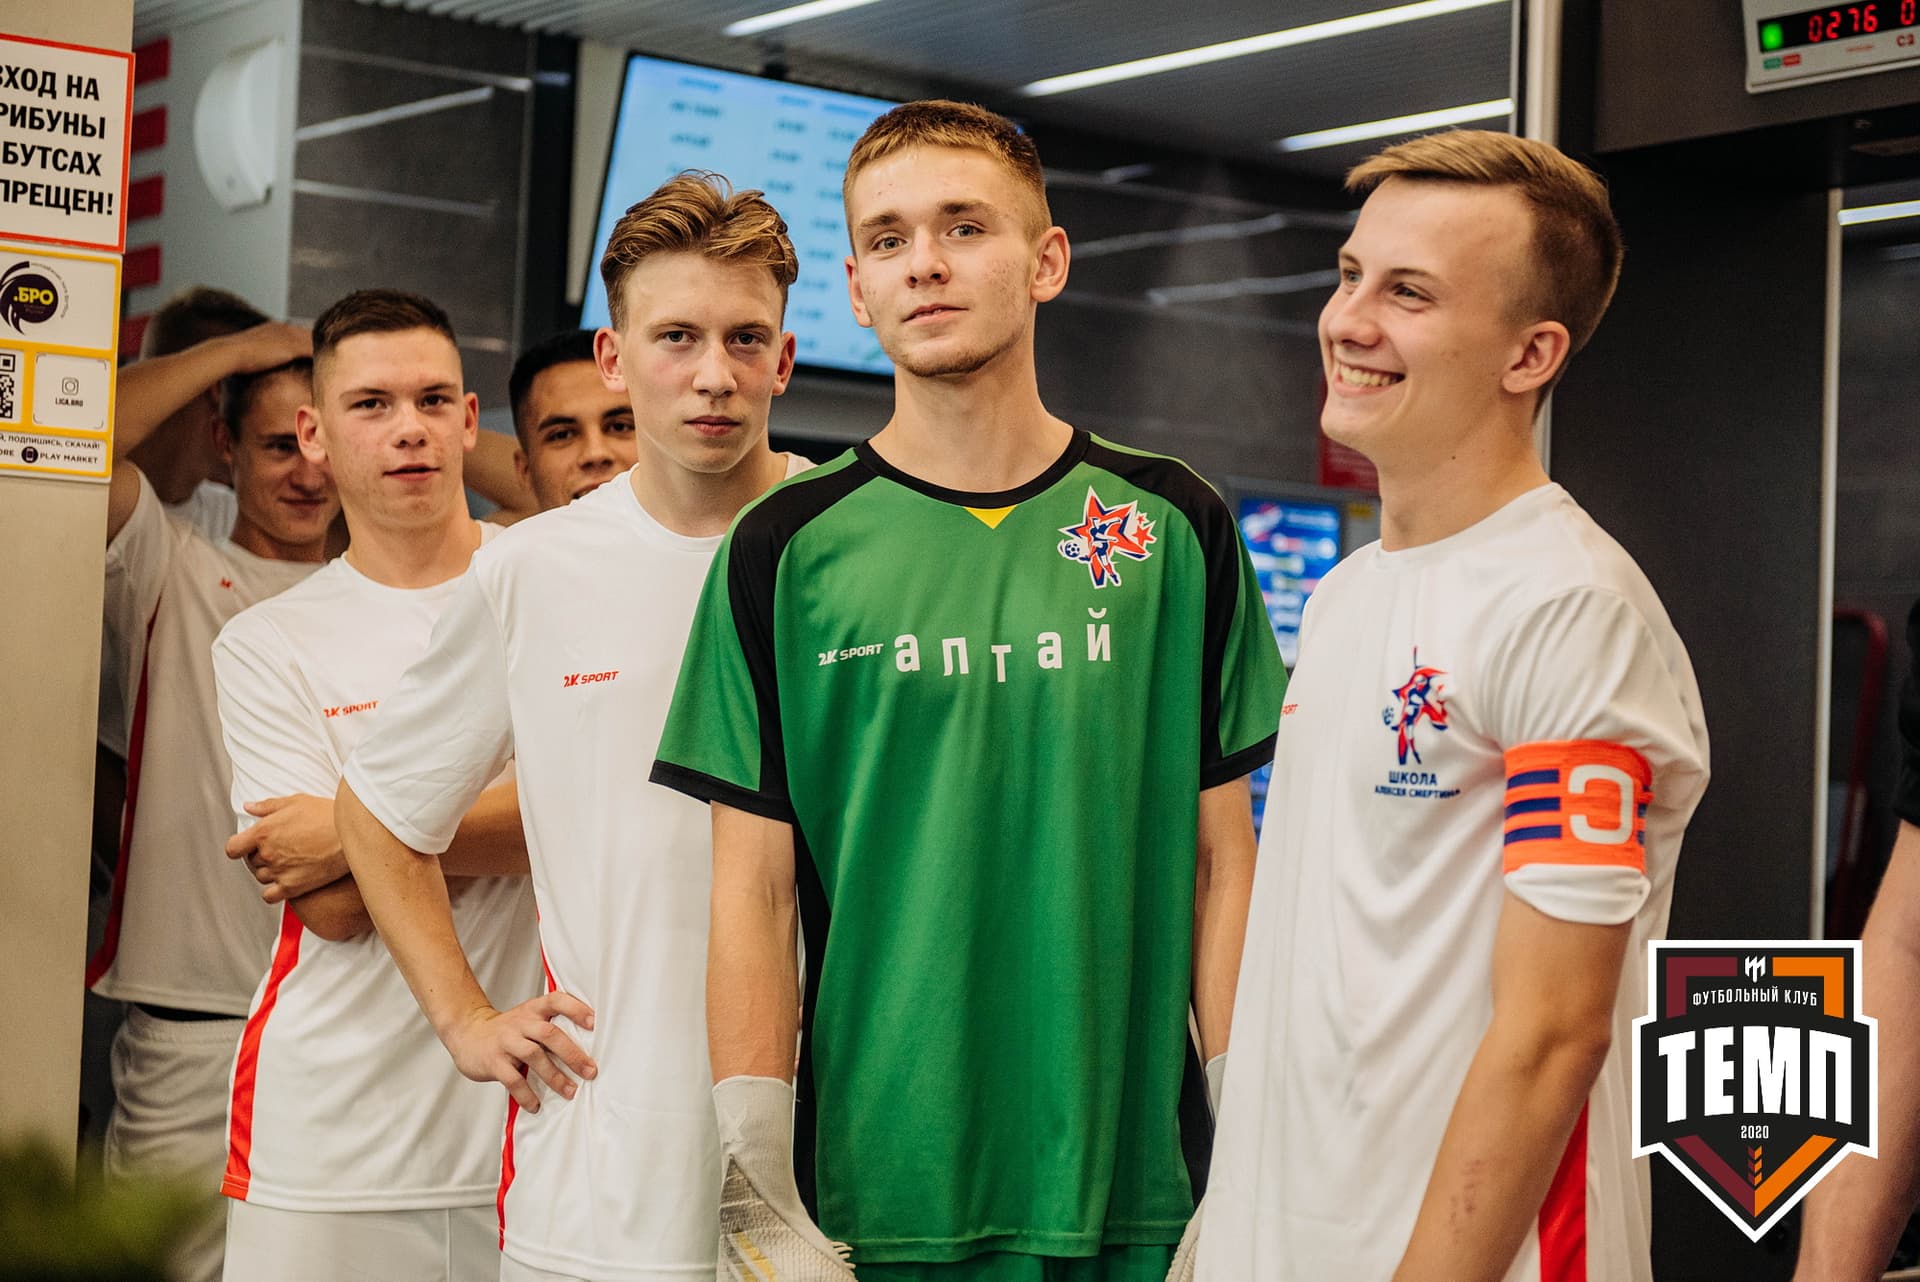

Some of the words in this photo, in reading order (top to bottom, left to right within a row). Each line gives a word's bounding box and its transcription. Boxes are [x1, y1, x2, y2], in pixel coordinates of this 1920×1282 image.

[1808, 4, 1878, 43] 0276
[0, 64, 57, 99] ХОД
[66, 75, 100, 101] НА
[2, 141, 102, 176] БУТСАХ
[40, 452, 61, 460] PLAY
[839, 643, 884, 661] SPORT
[580, 670, 619, 685] SPORT
[1388, 771, 1438, 786] ШКОЛА
